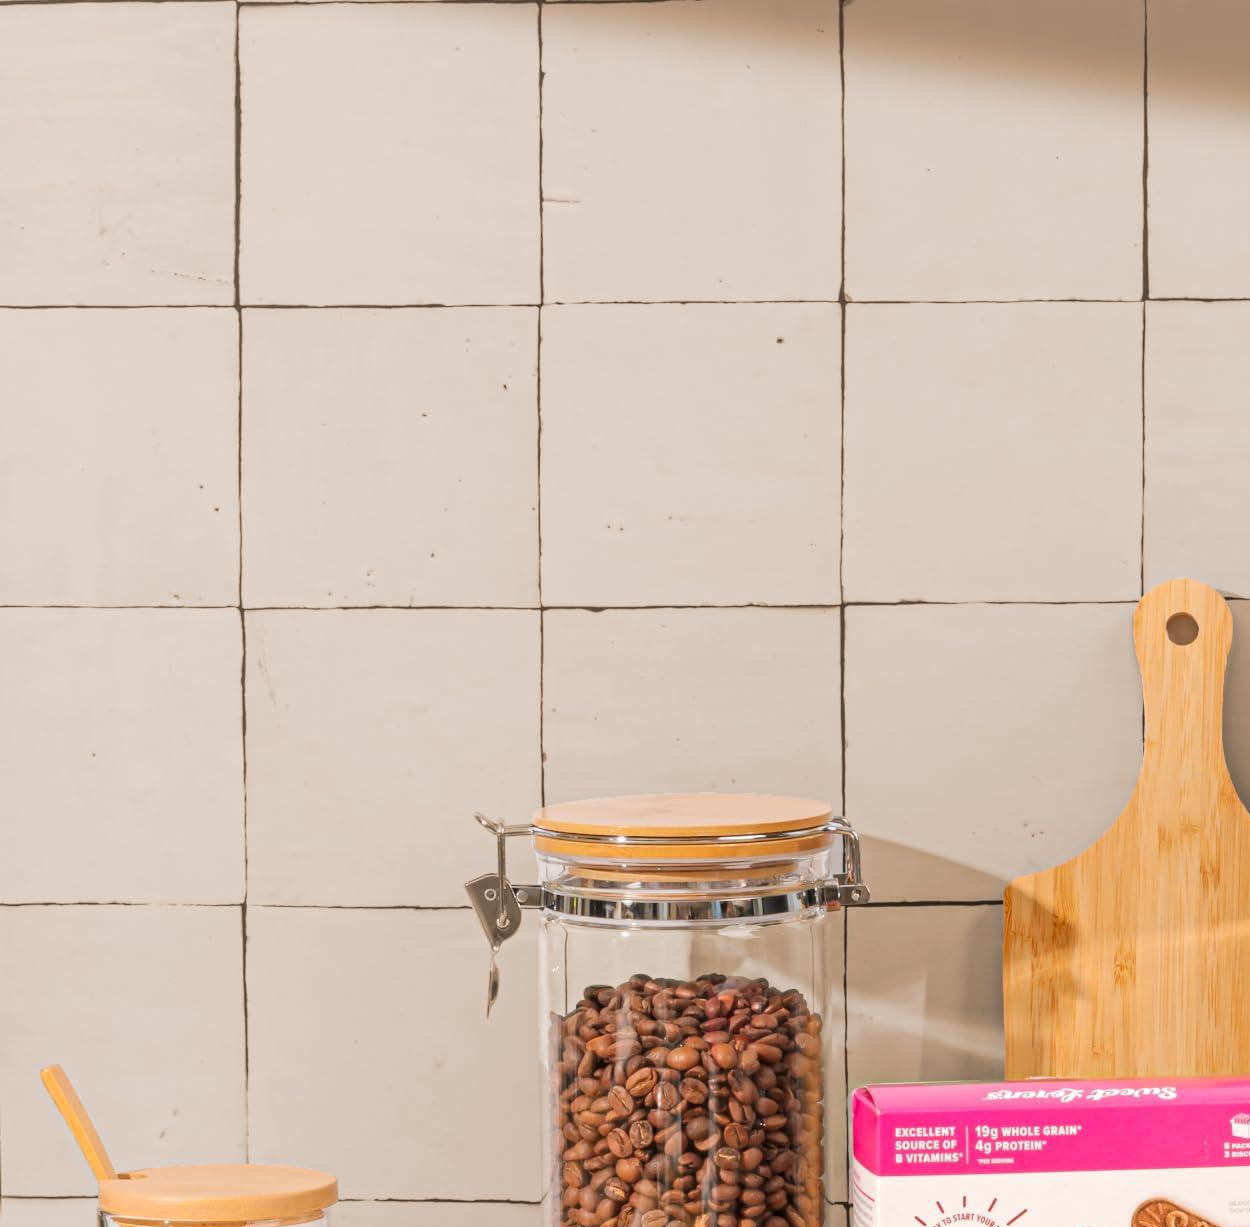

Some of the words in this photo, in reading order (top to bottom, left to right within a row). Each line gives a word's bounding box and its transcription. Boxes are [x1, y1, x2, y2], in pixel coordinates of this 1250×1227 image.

[986, 1087, 1084, 1103] Loren's
[1086, 1086, 1177, 1101] Sweet
[895, 1126, 956, 1138] EXCELLENT
[975, 1125, 999, 1140] 19g
[1001, 1126, 1040, 1137] WHOLE
[895, 1140, 940, 1150] SOURCE
[942, 1139, 958, 1149] OF
[975, 1139, 992, 1154] 4g
[895, 1153, 903, 1163] B
[942, 1217, 952, 1226] TO
[952, 1213, 974, 1223] START
